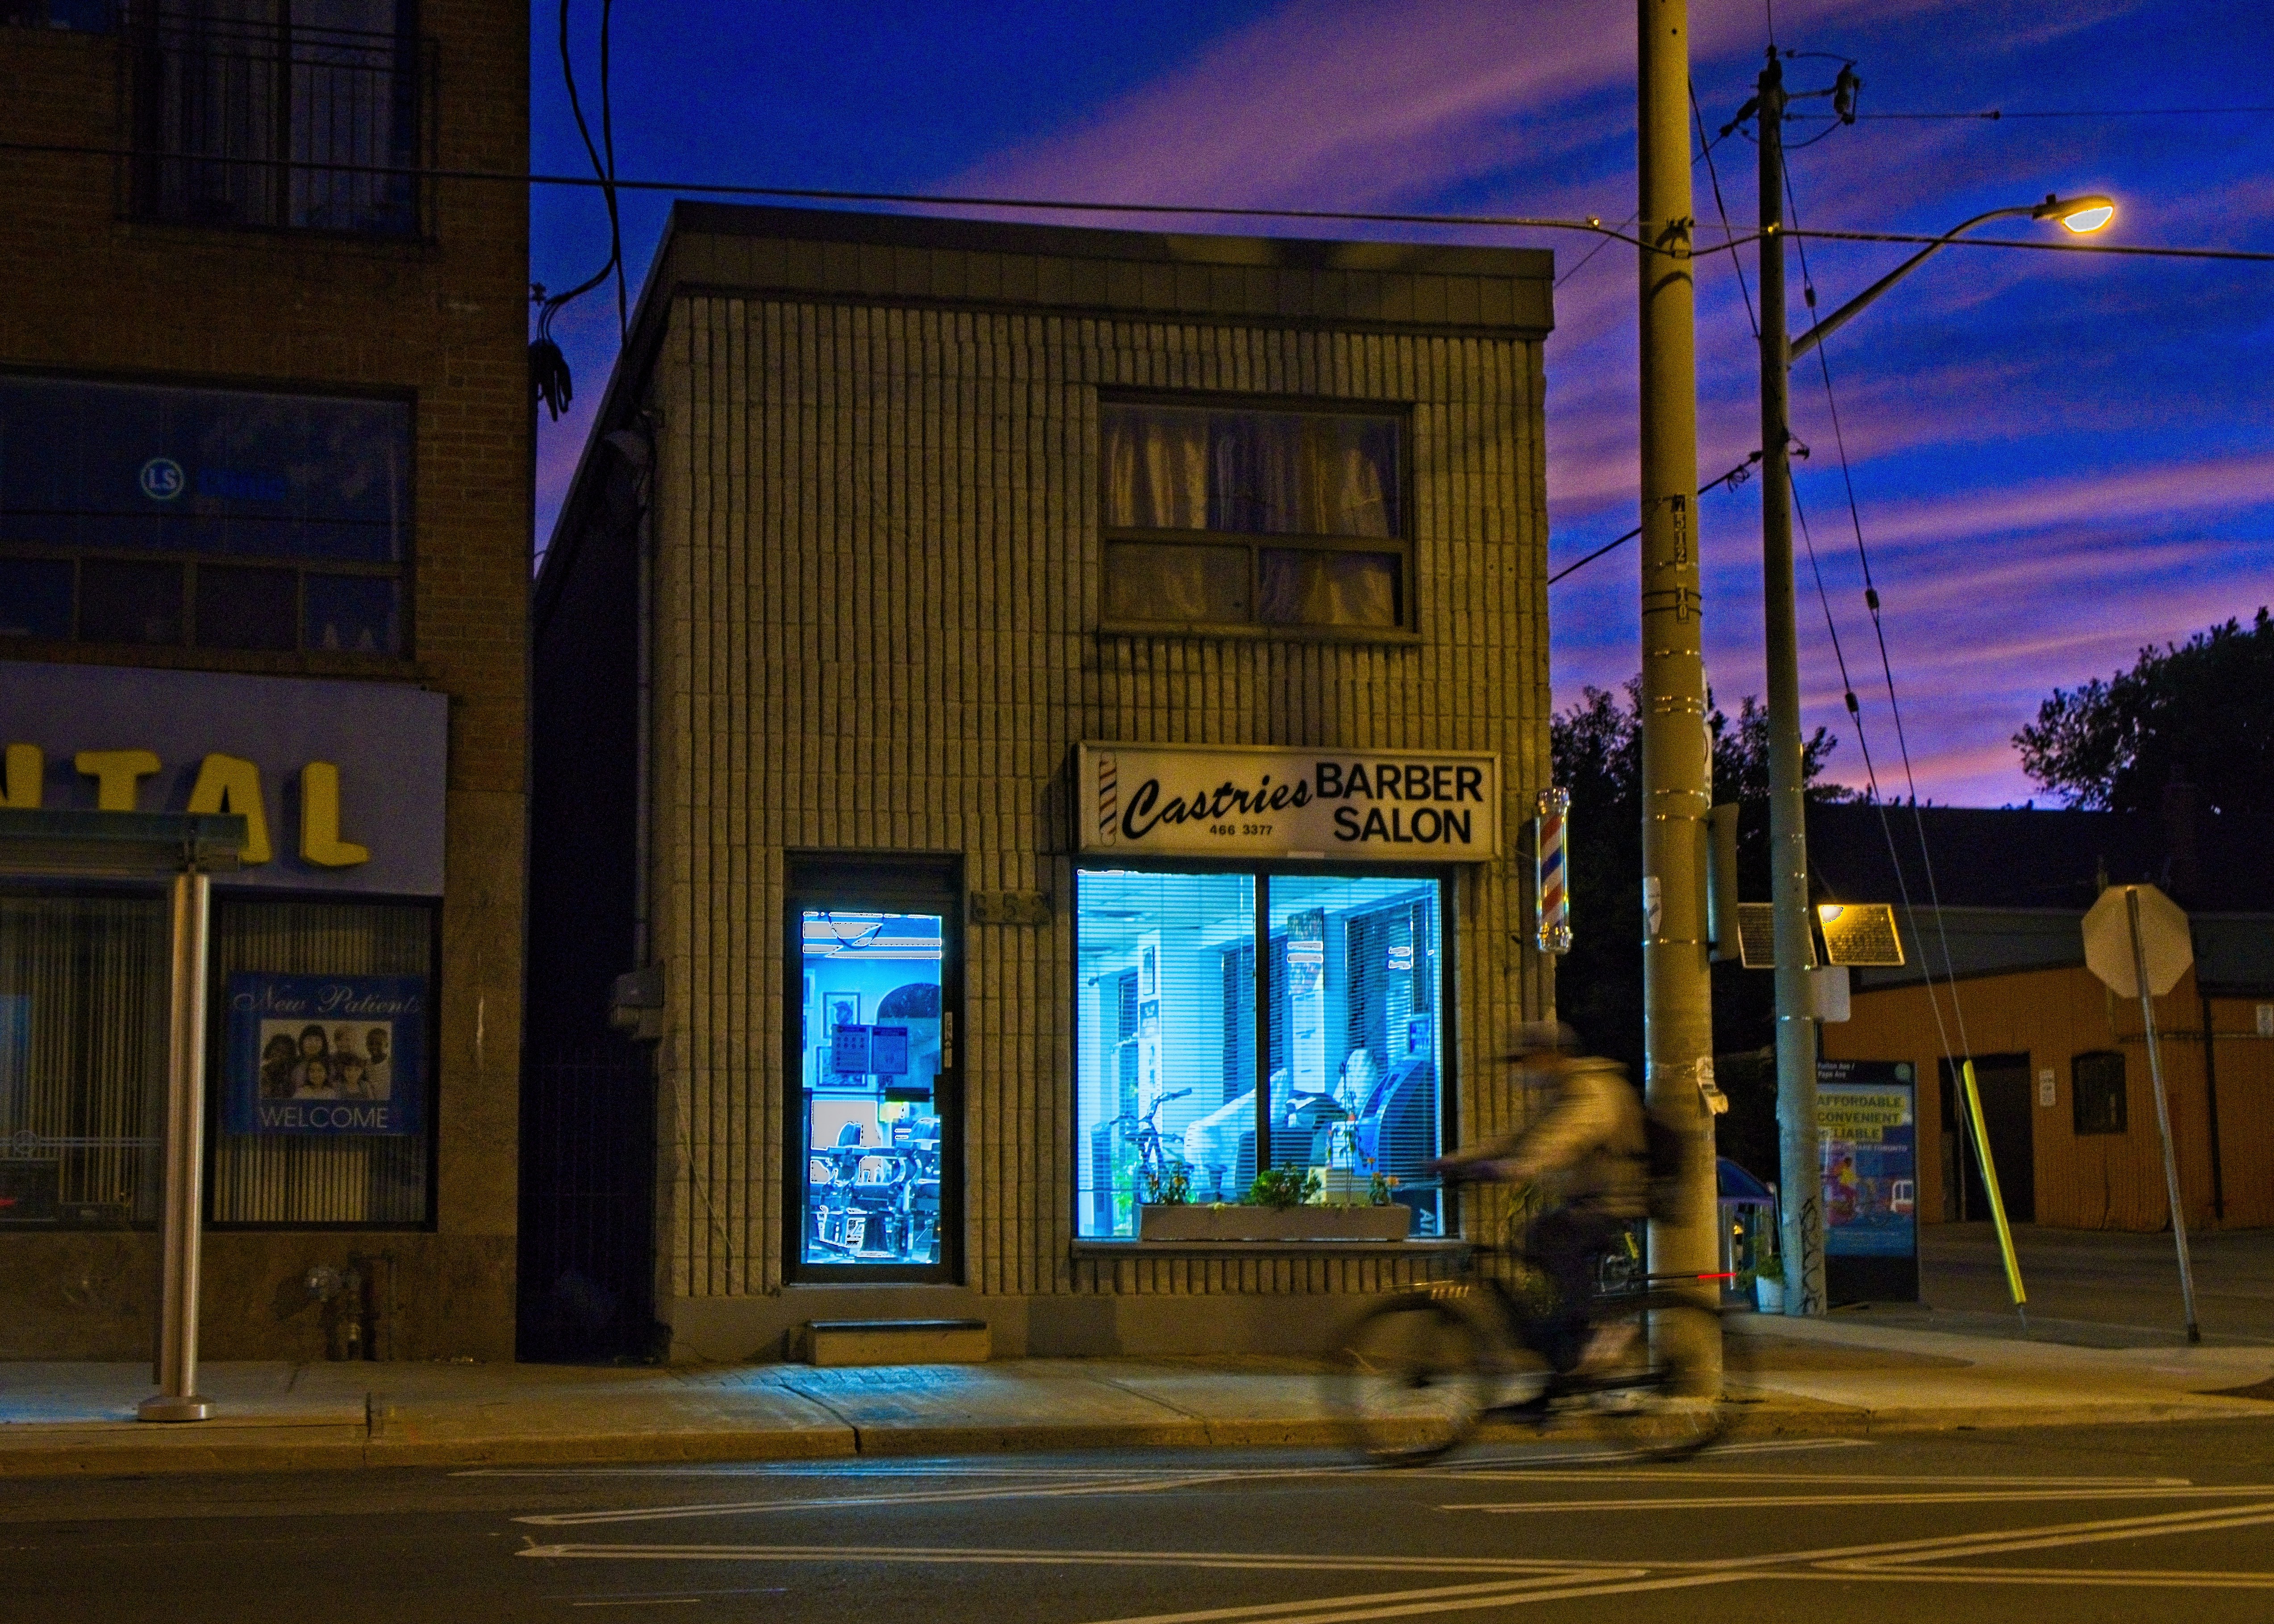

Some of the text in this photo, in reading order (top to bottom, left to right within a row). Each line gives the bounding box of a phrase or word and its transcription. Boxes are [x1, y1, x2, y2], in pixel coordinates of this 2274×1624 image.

[149, 468, 177, 490] LS
[0, 743, 371, 867] TAL
[1122, 763, 1483, 839] Castries BARBER
[1210, 824, 1273, 835] 466 3377
[1334, 807, 1470, 843] SALON
[233, 984, 421, 1014] New Patients
[1817, 1095, 1901, 1107] AFFORDABLE
[259, 1106, 389, 1129] WELCOME
[1818, 1112, 1900, 1123] CONVENIENT
[1818, 1127, 1880, 1140] LIABLE
